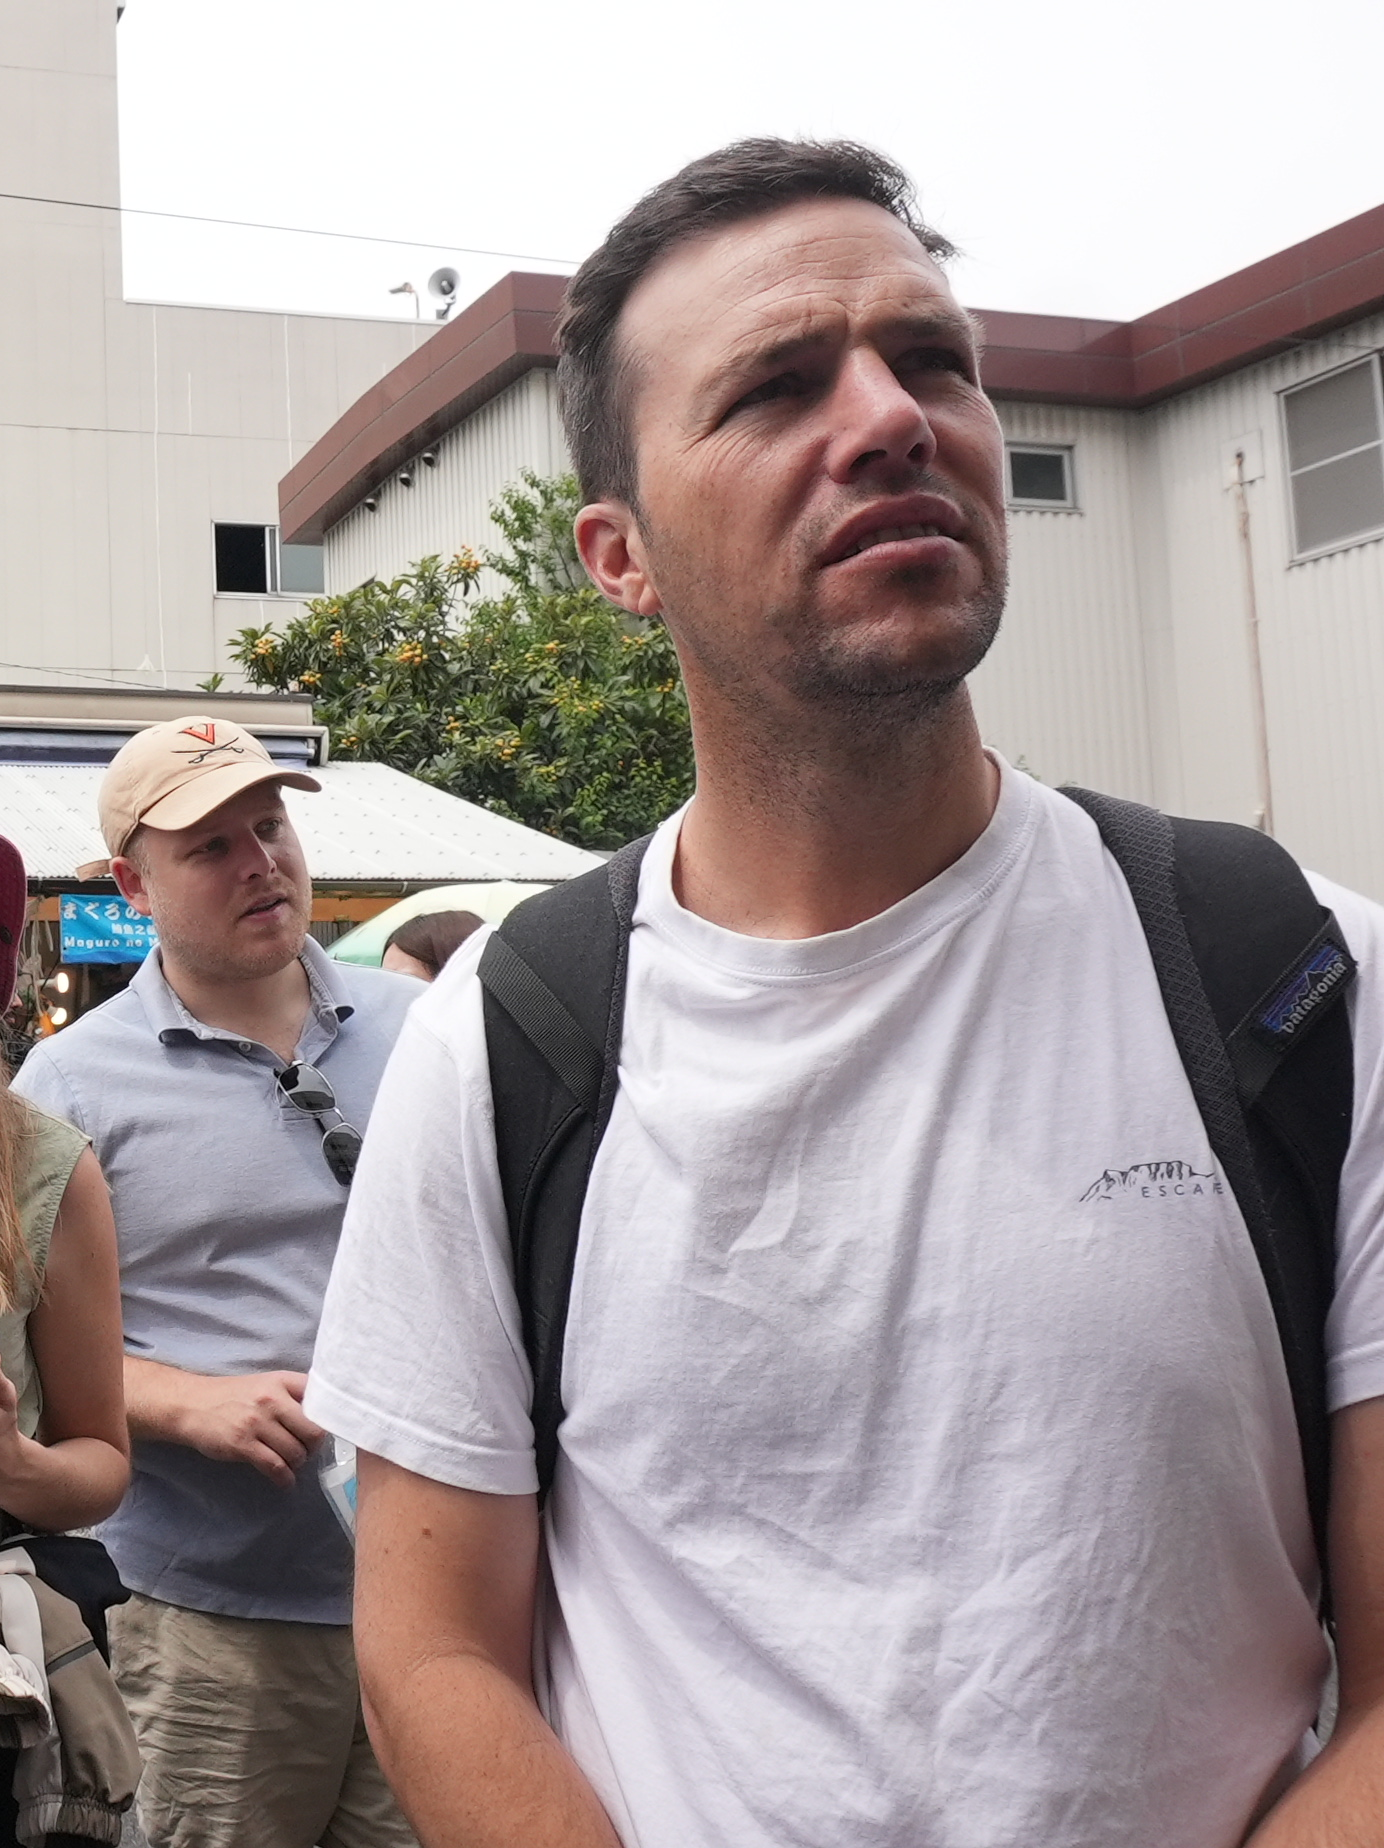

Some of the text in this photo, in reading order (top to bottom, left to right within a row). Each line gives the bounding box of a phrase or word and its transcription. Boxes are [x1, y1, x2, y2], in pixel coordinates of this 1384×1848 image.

[63, 902, 153, 921] まぐろの
[64, 936, 120, 949] Maguro
[126, 938, 143, 947] no
[1281, 961, 1348, 1034] patagonia
